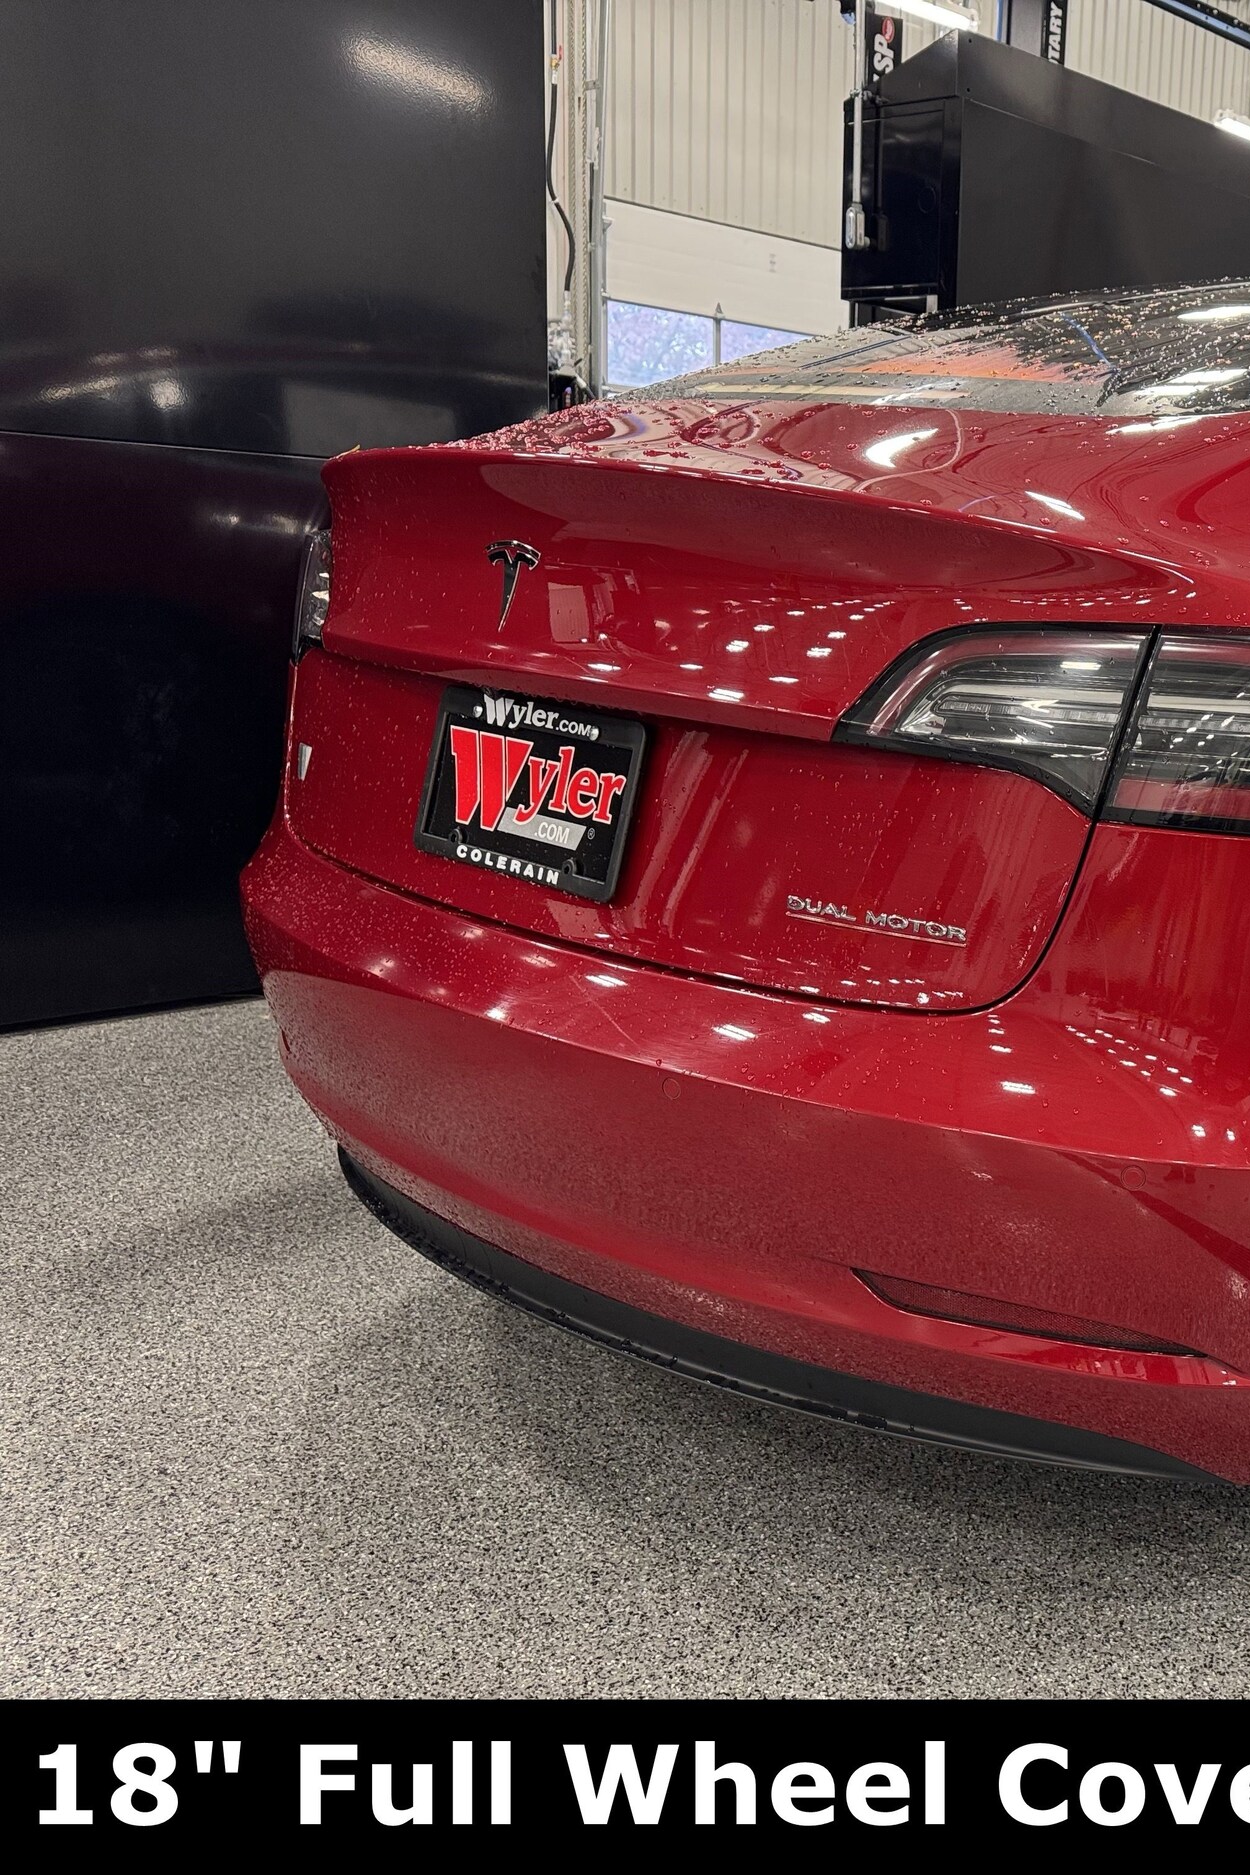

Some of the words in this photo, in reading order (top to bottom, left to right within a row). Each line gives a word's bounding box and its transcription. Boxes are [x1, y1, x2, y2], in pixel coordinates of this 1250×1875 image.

[450, 724, 626, 832] Wyler
[456, 844, 559, 886] COLERAIN
[786, 894, 857, 922] DUAL
[864, 910, 967, 942] MOTOR
